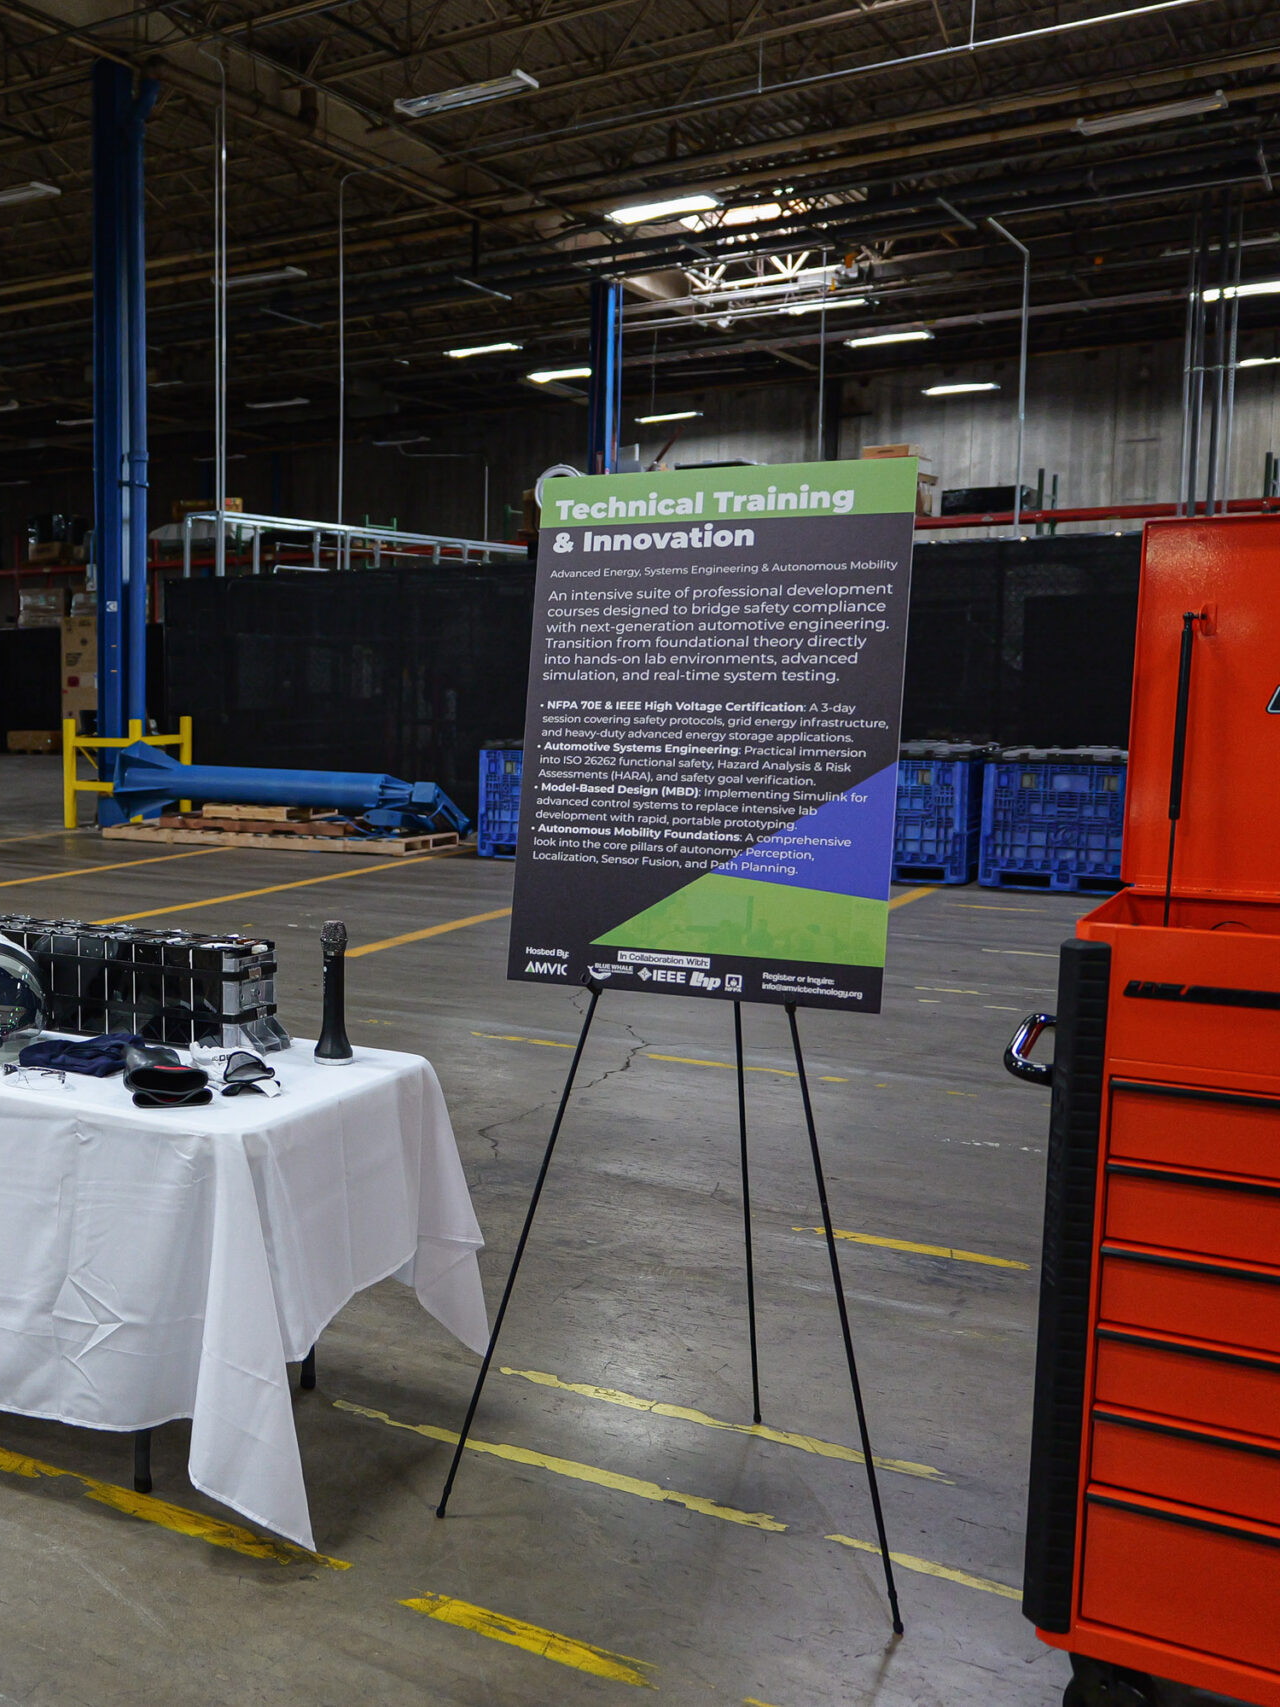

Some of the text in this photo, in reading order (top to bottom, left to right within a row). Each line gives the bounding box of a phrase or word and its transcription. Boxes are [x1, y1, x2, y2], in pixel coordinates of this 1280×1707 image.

[556, 484, 854, 520] Technical Training
[553, 523, 754, 553] & Innovation
[550, 560, 898, 578] Advanced Energy, Systems Engineering & Autonomous Mobility
[548, 584, 892, 601] An intensive suite of professional development
[548, 600, 886, 618] courses designed to bridge safety compliance
[547, 617, 889, 634] with next-generation automotive engineering.
[546, 635, 866, 649] Transition from foundational theory directly
[545, 652, 858, 665] into hands-on lab environments, advanced
[543, 669, 839, 684] simulation, and real-time system testing.
[548, 701, 856, 714] NFPA 70E & IEEE High Voltage Certification: A 3-day
[543, 714, 888, 729] session covering safety protocols, grid energy infrastructure,
[542, 728, 853, 743] and heavy-duty advanced energy storage applications.
[544, 742, 866, 757] Automotive Systems Engineering: Practical immersion
[540, 755, 851, 772] into ISO 26262 functional safety, Hazard Analysis & Risk
[538, 769, 816, 786] Assessments (HARA), and safety goal verification.
[542, 783, 867, 802] Model-Based Design (MBD): Implementing Simulink for
[537, 796, 588, 806] advanced
[591, 799, 630, 808] control
[633, 801, 678, 810] systems
[696, 802, 738, 813] replace
[742, 803, 795, 814] intensive
[799, 806, 817, 815] lab
[536, 810, 797, 831] development with rapid, portable prototyping.
[538, 824, 851, 846] Autonomous Mobility Foundations: A comprehensive
[534, 837, 814, 861] look into the core pillars of autonomy: Perception,
[533, 851, 798, 875] Localization, Sensor Fusion, and Path Planning.
[526, 946, 556, 956] Hosted
[620, 952, 627, 960] In
[628, 953, 684, 964] Collaboration
[524, 961, 568, 976] AMVIC
[652, 970, 686, 983] IEEE
[762, 972, 796, 983] Register
[807, 976, 834, 986] Inquire:
[762, 982, 862, 999] info@amvictechnology.org
